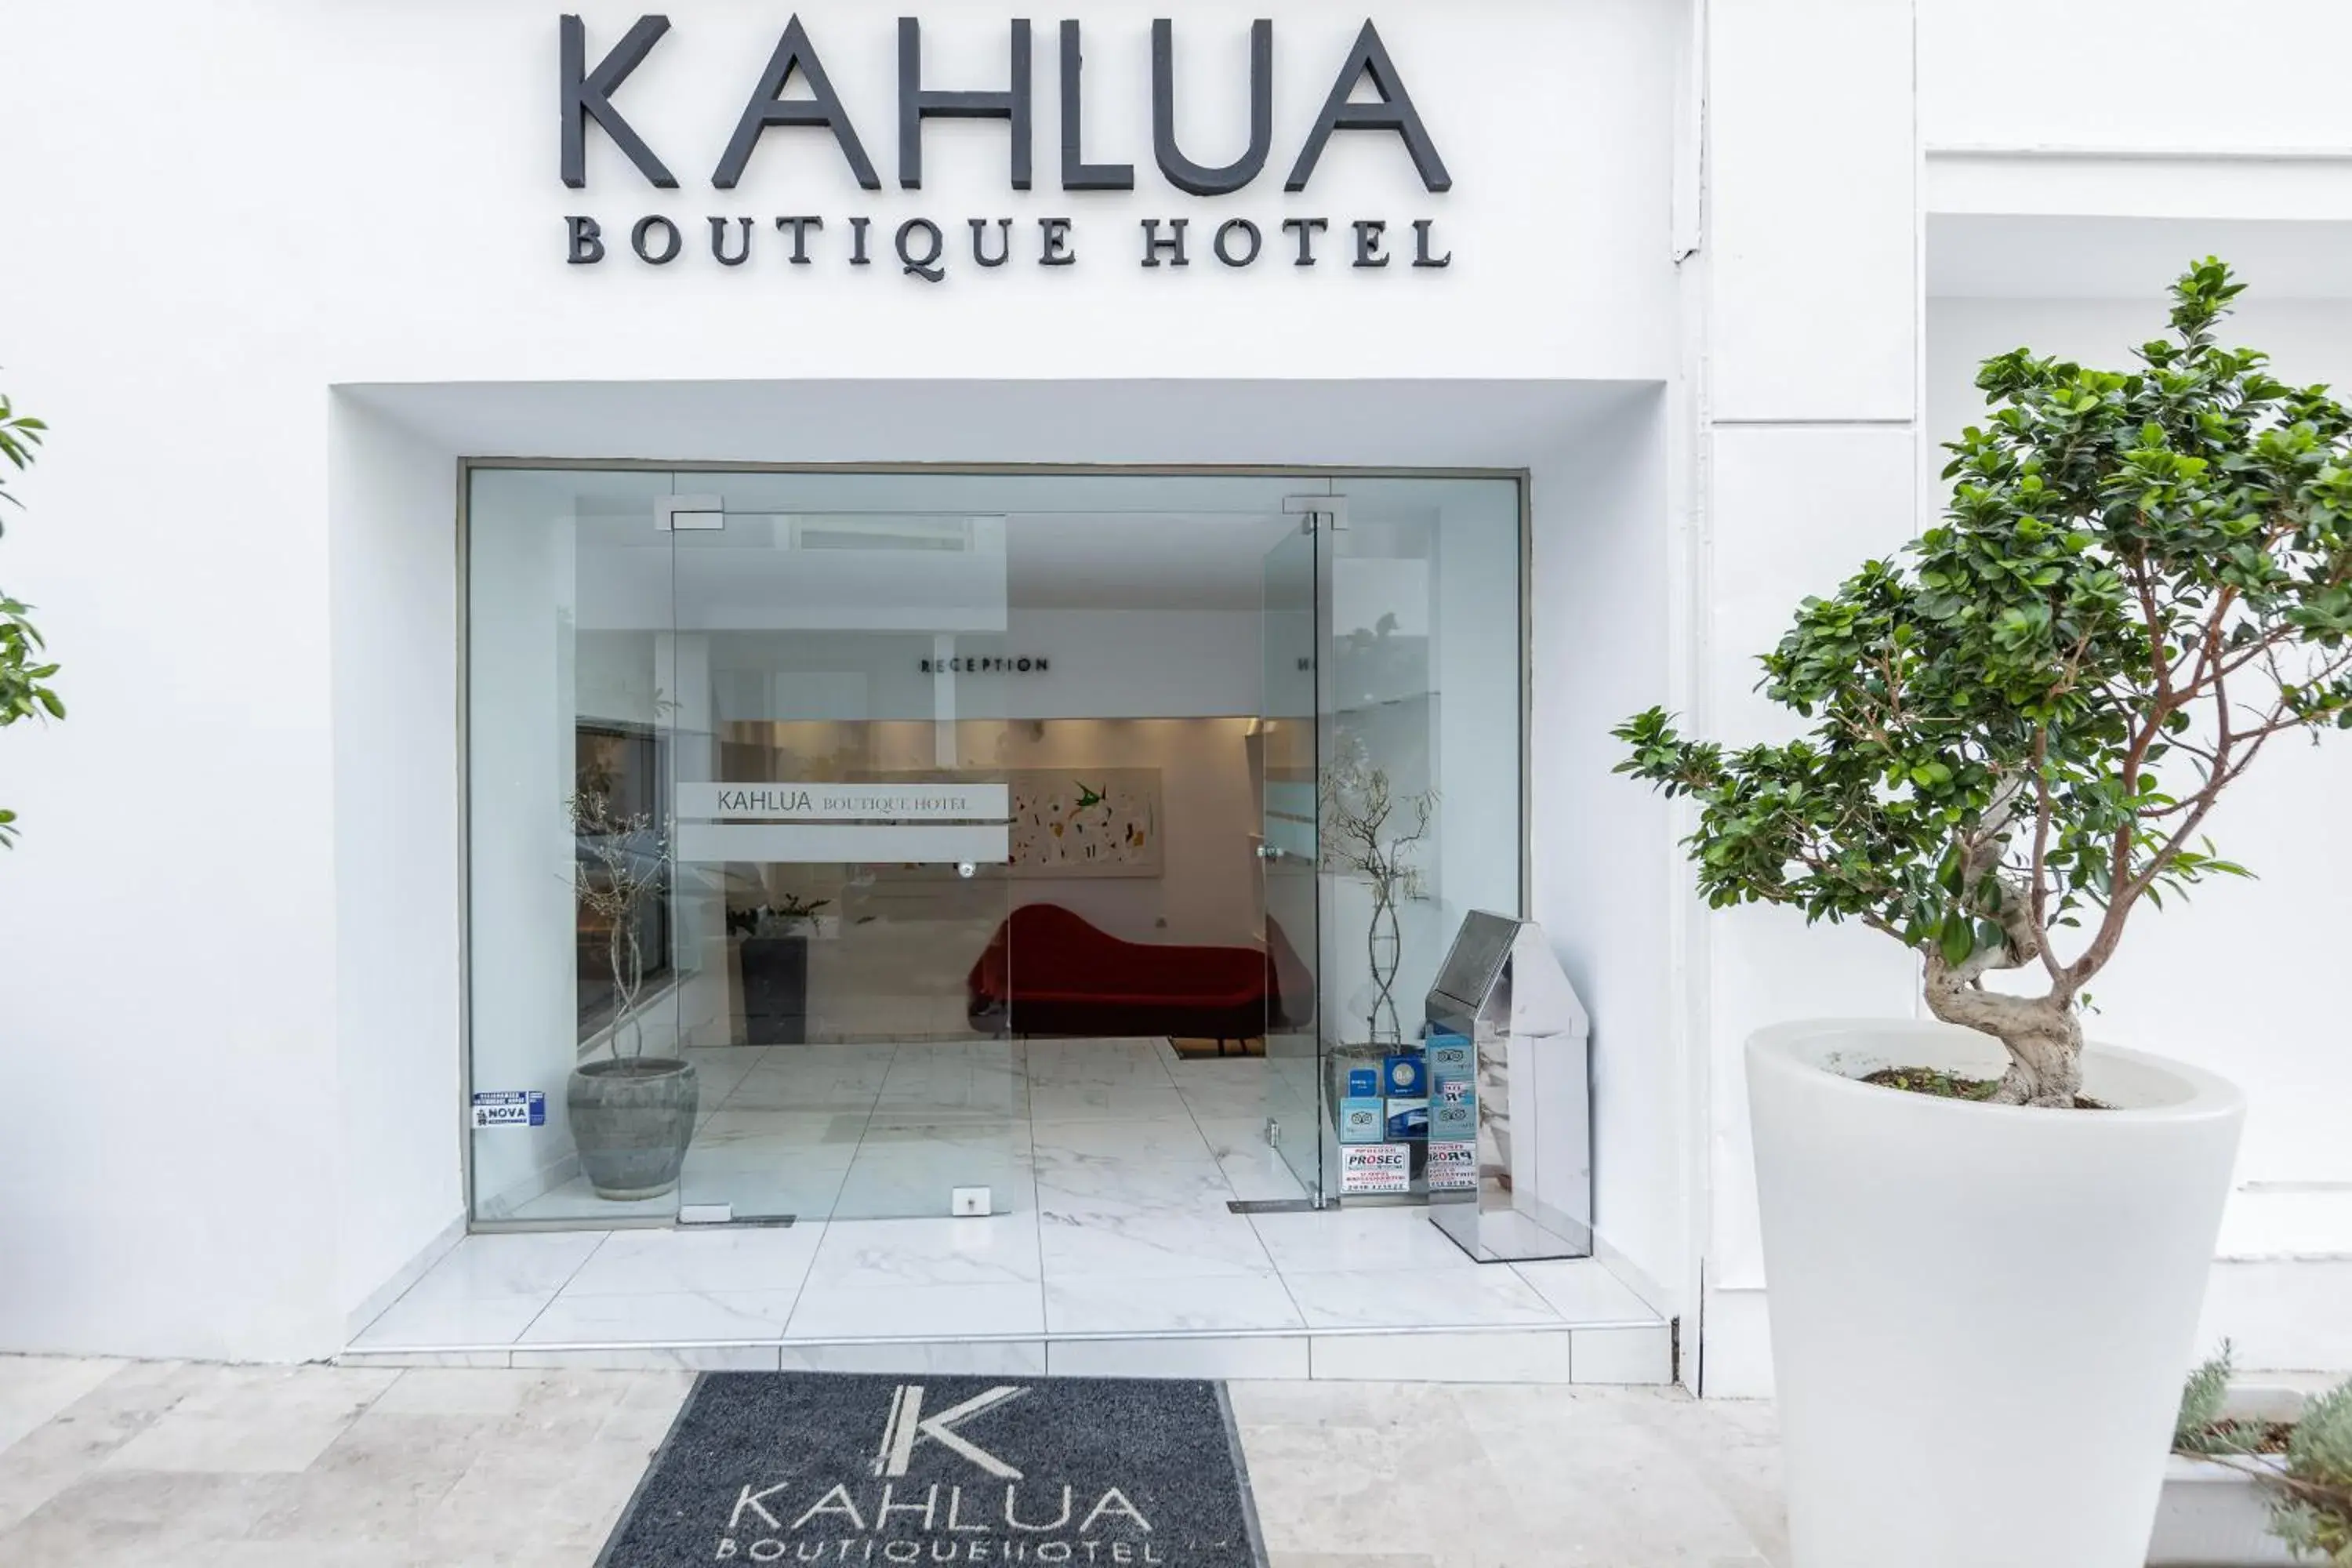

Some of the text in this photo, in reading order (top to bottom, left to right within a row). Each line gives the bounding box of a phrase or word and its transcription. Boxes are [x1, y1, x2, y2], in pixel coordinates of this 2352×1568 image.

[560, 13, 1453, 196] KAHLUA
[564, 214, 1452, 282] BOUTIQUE HOTEL
[920, 657, 1047, 673] RECEPTION
[717, 789, 971, 814] KAHLUA BOUTIQUE HOTEL
[488, 1108, 525, 1117] NOVA
[728, 1482, 1152, 1531] KAHLUA
